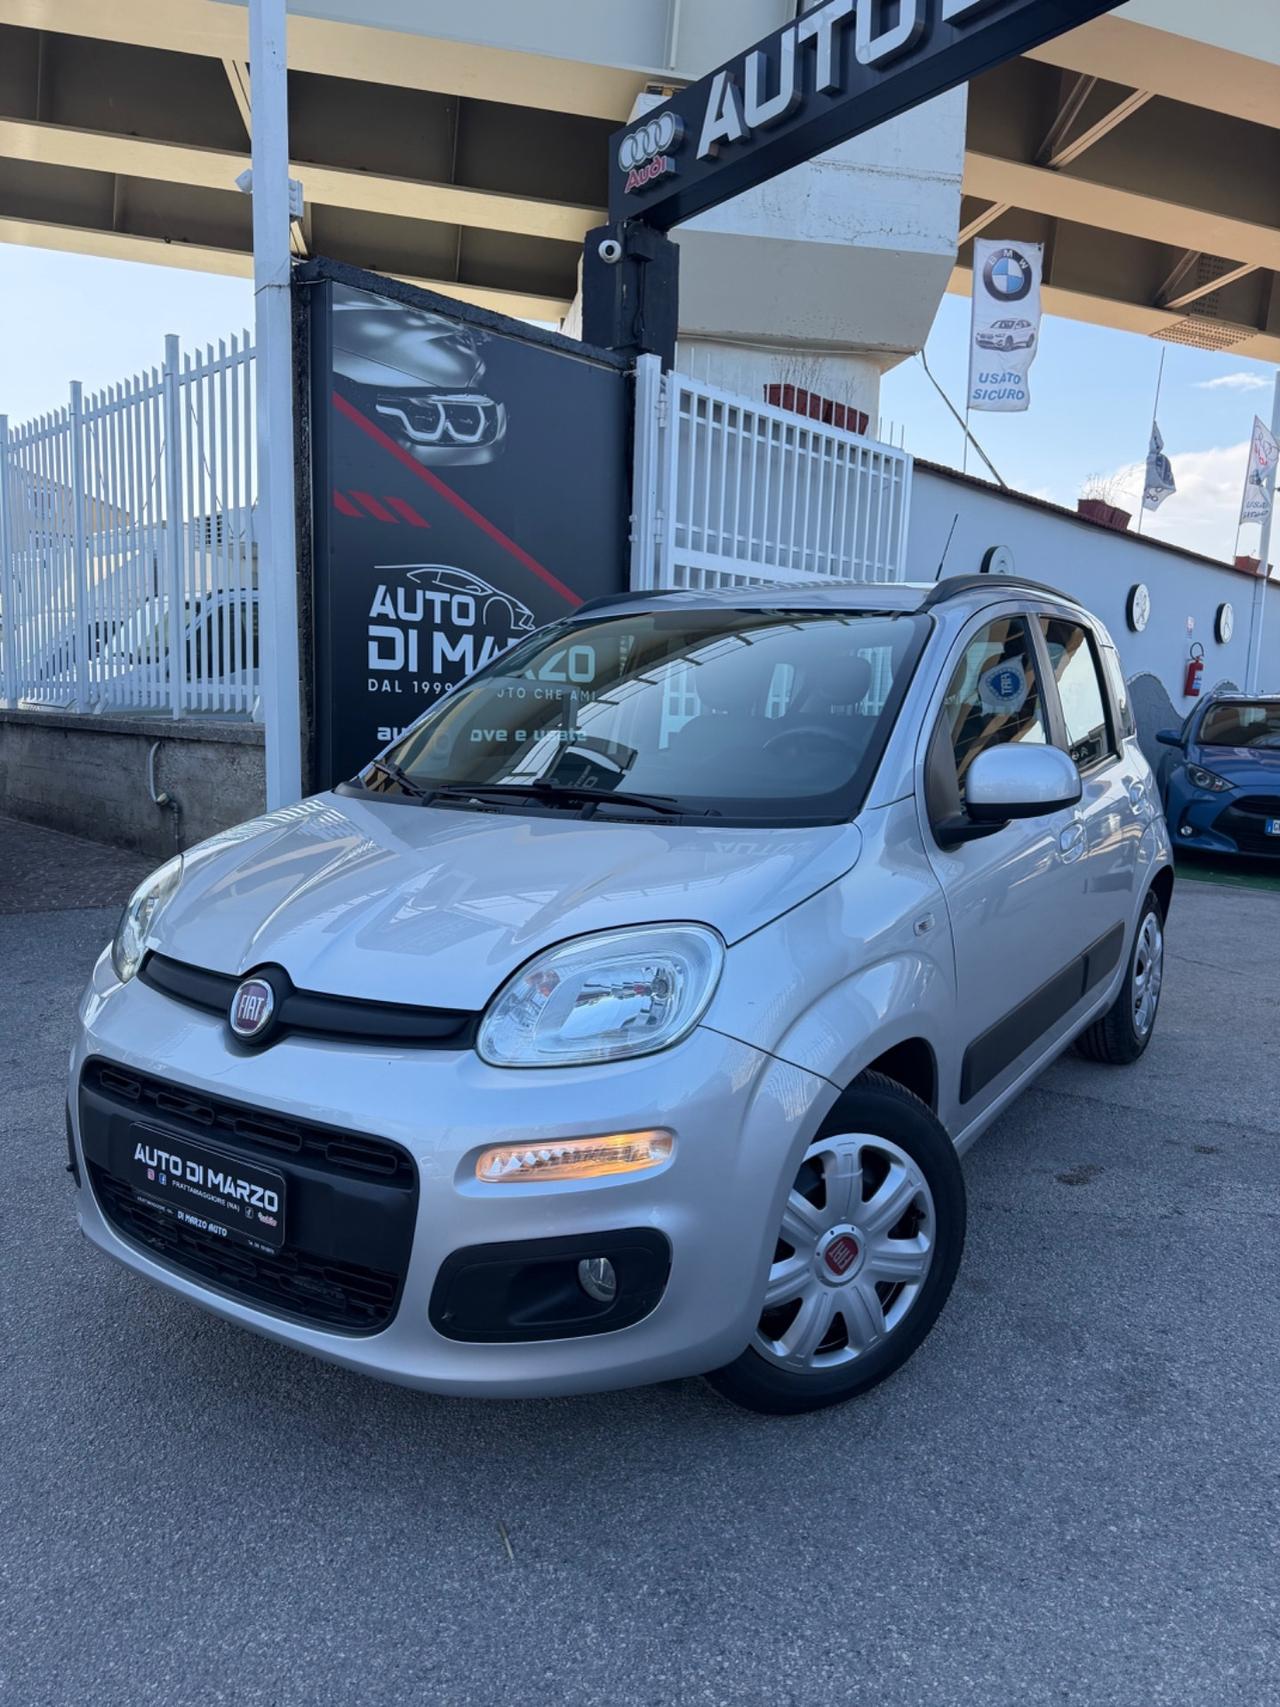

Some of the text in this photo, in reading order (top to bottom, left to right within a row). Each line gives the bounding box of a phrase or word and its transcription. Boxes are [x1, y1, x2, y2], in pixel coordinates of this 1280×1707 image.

[624, 155, 668, 194] Audi
[989, 249, 1029, 270] BMW
[978, 372, 1022, 385] USATO
[972, 388, 1025, 401] SICURO
[369, 585, 476, 627] AUTO
[368, 625, 418, 673] DI
[368, 679, 402, 693] DAL
[534, 689, 562, 700] CHE
[515, 729, 527, 741] e
[238, 994, 264, 1021] FIAT
[134, 1143, 183, 1177] AUTO
[186, 1161, 203, 1185] DI
[207, 1168, 279, 1213] MARZO
[177, 1211, 228, 1238] DI MARZO AUTO
[828, 1240, 855, 1272] FIAT
